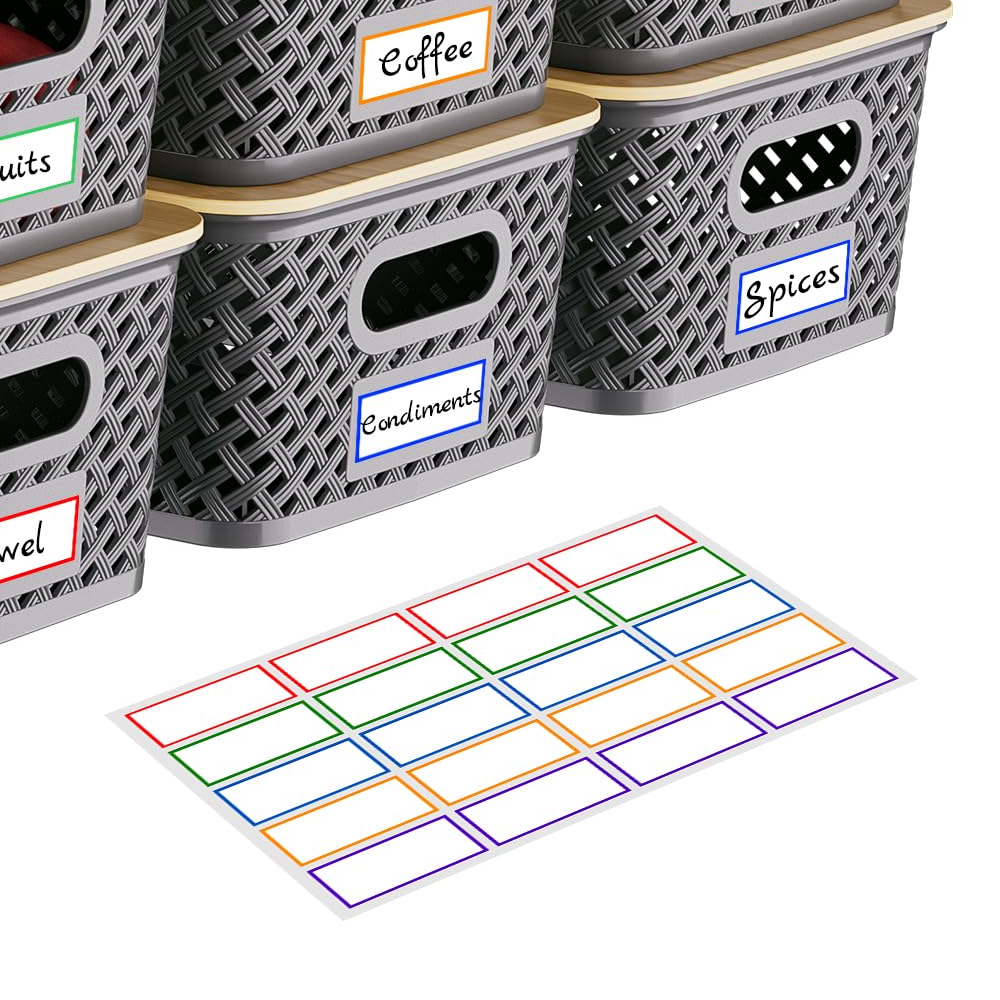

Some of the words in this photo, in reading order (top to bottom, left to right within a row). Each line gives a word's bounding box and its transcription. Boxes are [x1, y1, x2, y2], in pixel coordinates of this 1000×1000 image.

[378, 31, 473, 79] Coffee
[743, 264, 840, 319] Spices
[359, 386, 482, 435] Condiments
